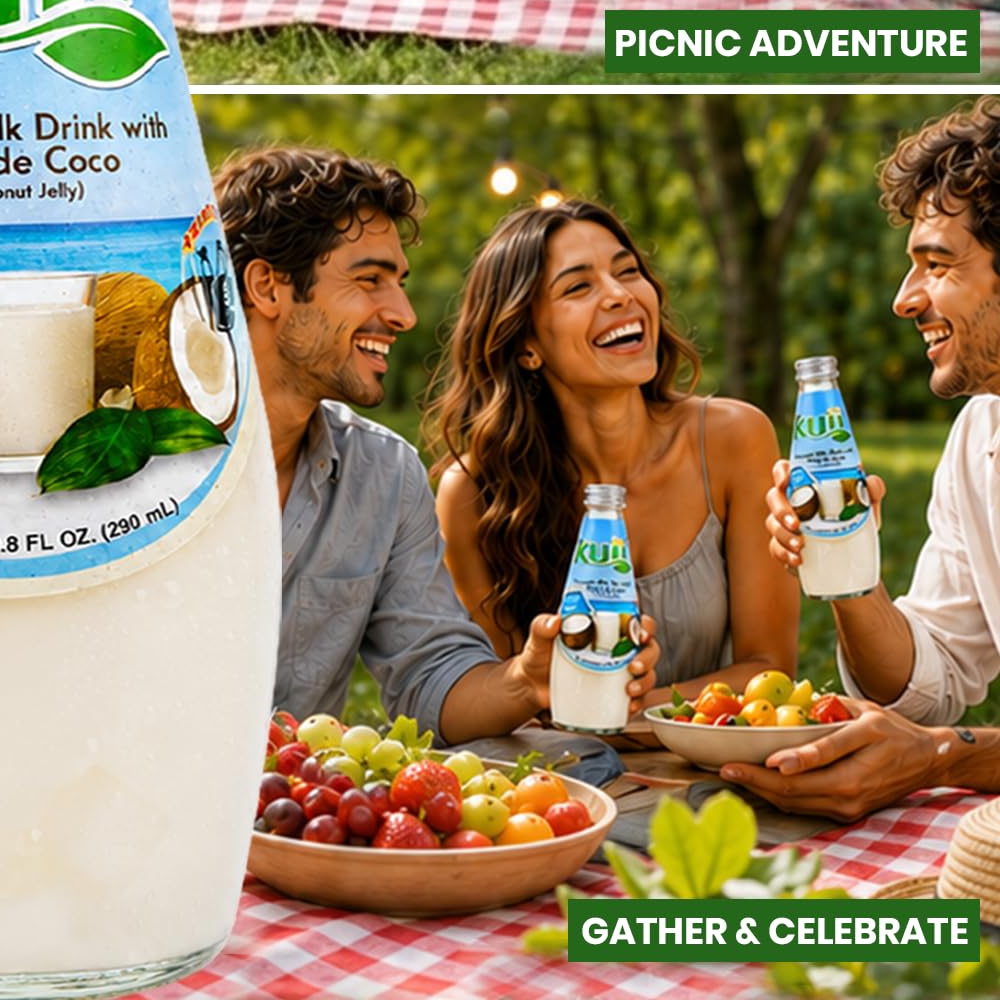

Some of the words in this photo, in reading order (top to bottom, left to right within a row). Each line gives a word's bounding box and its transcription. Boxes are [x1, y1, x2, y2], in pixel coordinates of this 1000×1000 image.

[34, 112, 113, 141] Drink
[121, 111, 169, 140] with
[45, 145, 121, 174] Coco
[38, 181, 85, 203] Jelly)
[26, 533, 53, 552] FL
[59, 527, 98, 549] OZ.
[100, 513, 142, 544] (290
[146, 497, 181, 526] mL)
